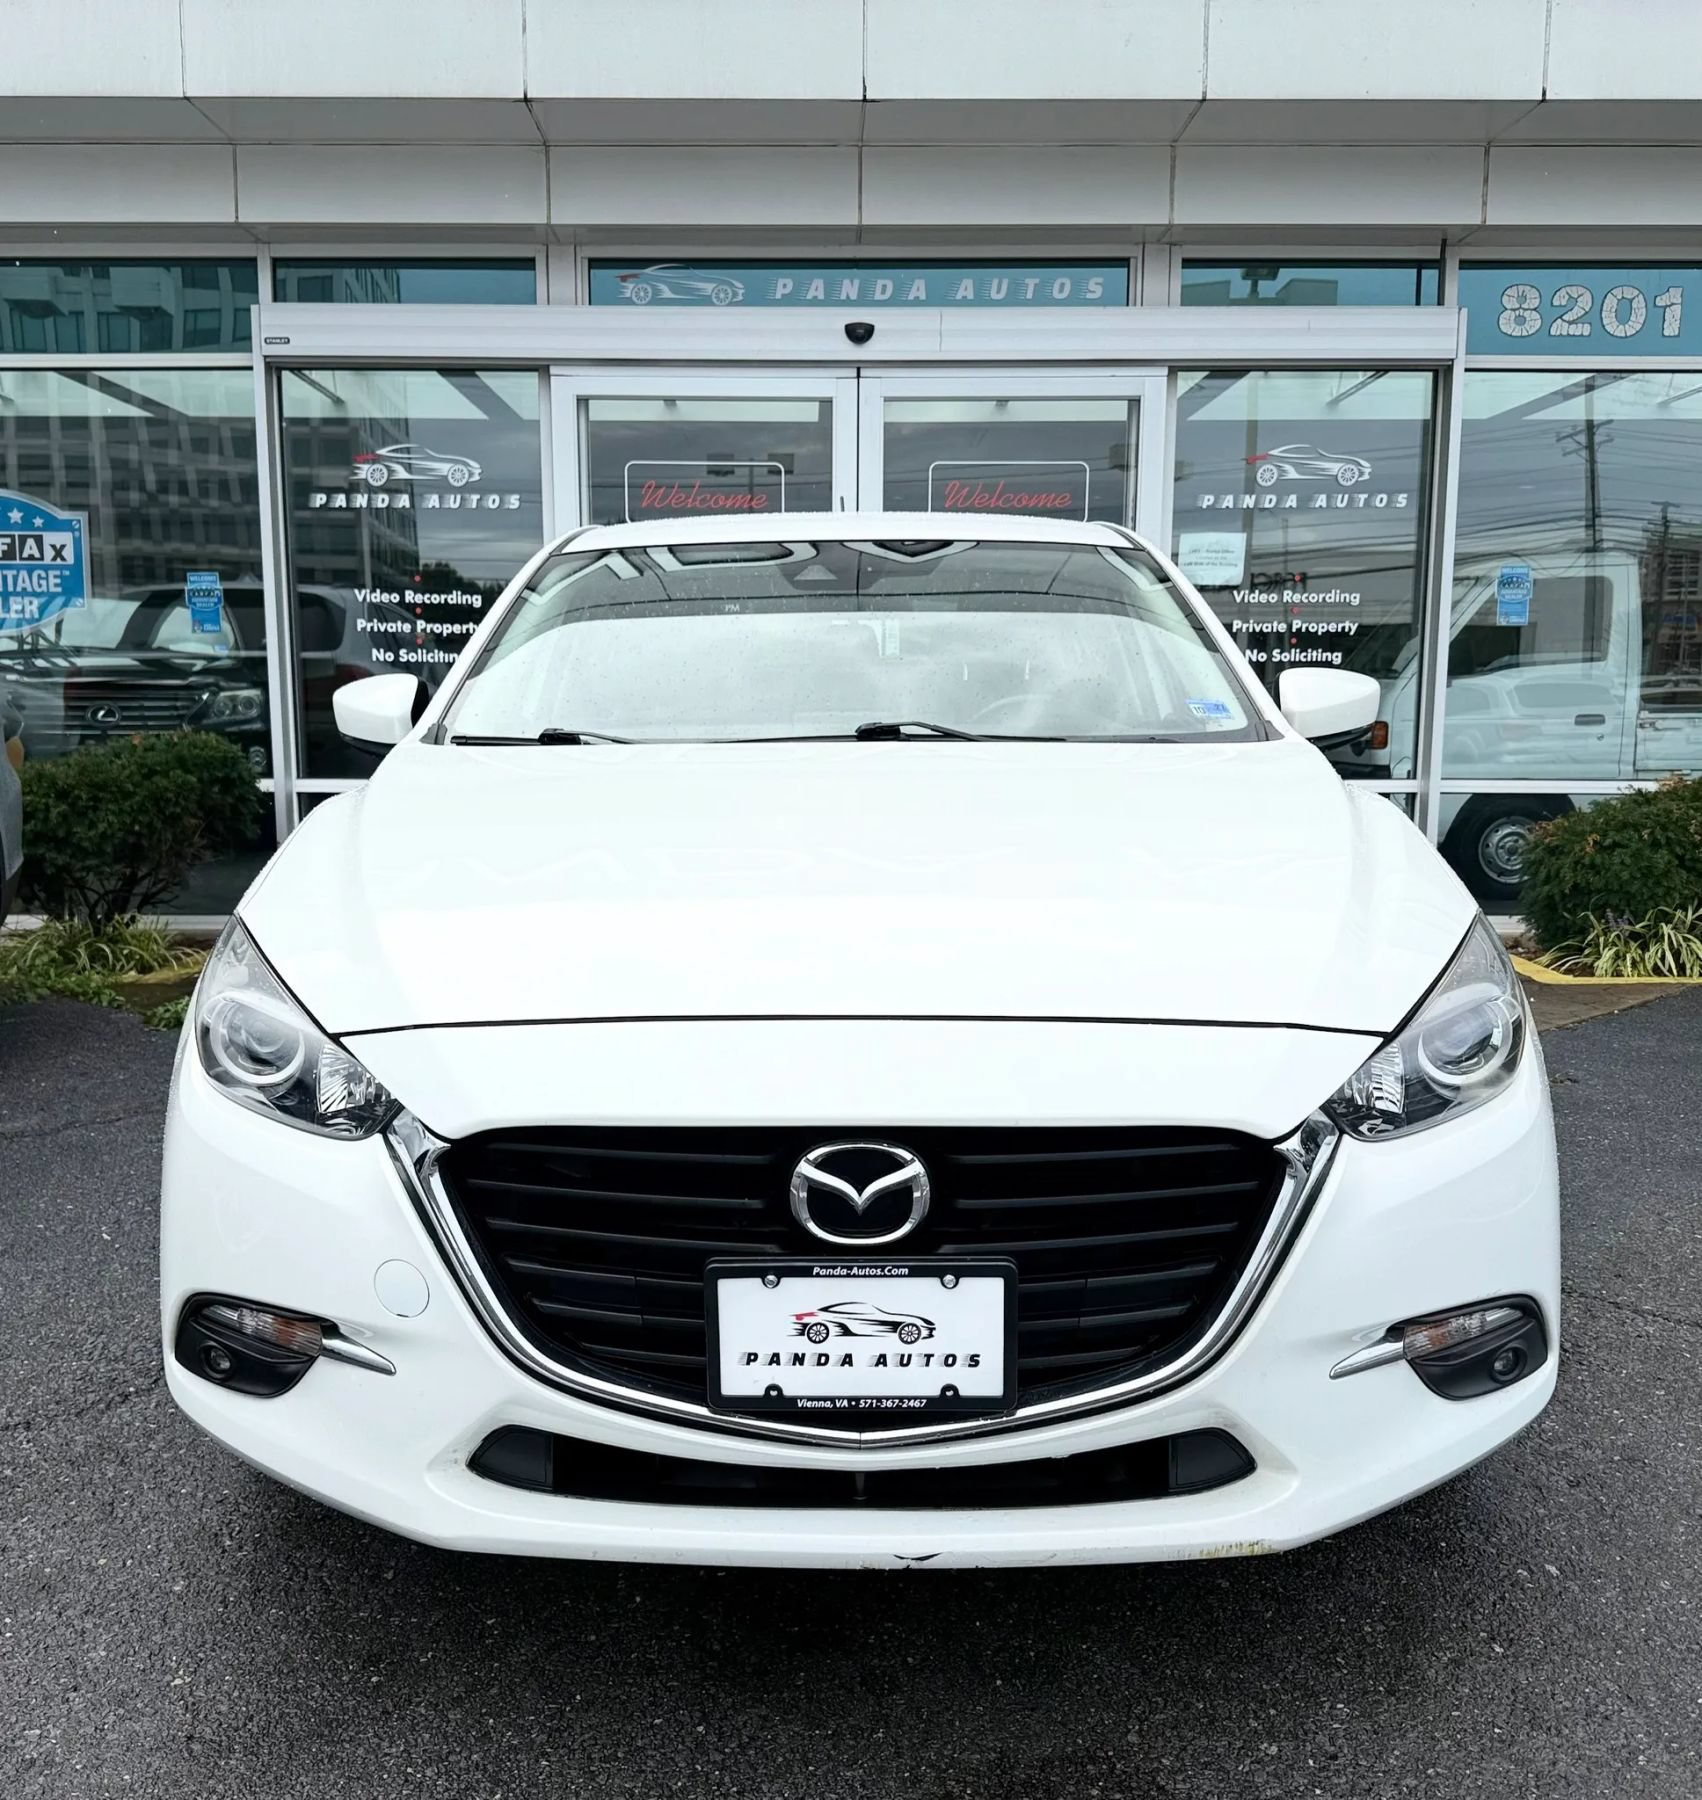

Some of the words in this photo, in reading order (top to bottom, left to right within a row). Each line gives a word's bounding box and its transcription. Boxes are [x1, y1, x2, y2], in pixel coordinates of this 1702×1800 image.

[773, 277, 927, 300] PANDA
[954, 277, 1103, 300] AUTOS
[1497, 284, 1683, 339] 8201
[313, 493, 411, 508] PANDA
[426, 493, 520, 509] AUTOS
[639, 479, 769, 509] Welcome
[944, 479, 1073, 509] Welcome
[1199, 493, 1298, 509] PANDA
[1313, 493, 1408, 508] AUTOS
[354, 588, 400, 604] Video
[404, 589, 482, 608] Recording
[1232, 590, 1278, 603] Video
[1282, 590, 1360, 605] Recording
[356, 619, 412, 633] Private
[416, 620, 478, 637] Propert
[1232, 619, 1287, 633] Private
[1291, 620, 1359, 636] Property
[371, 648, 394, 662] No
[398, 648, 459, 663] Solicitin
[1245, 648, 1268, 662] No
[1271, 648, 1343, 665] Soliciting
[812, 1266, 909, 1276] Panda-Autos.Com
[743, 1352, 854, 1367] PANDA
[874, 1352, 981, 1367] AUTOS
[797, 1399, 834, 1408] Vienna,
[835, 1399, 849, 1408] VA
[858, 1399, 927, 1408] 571-367-2467
